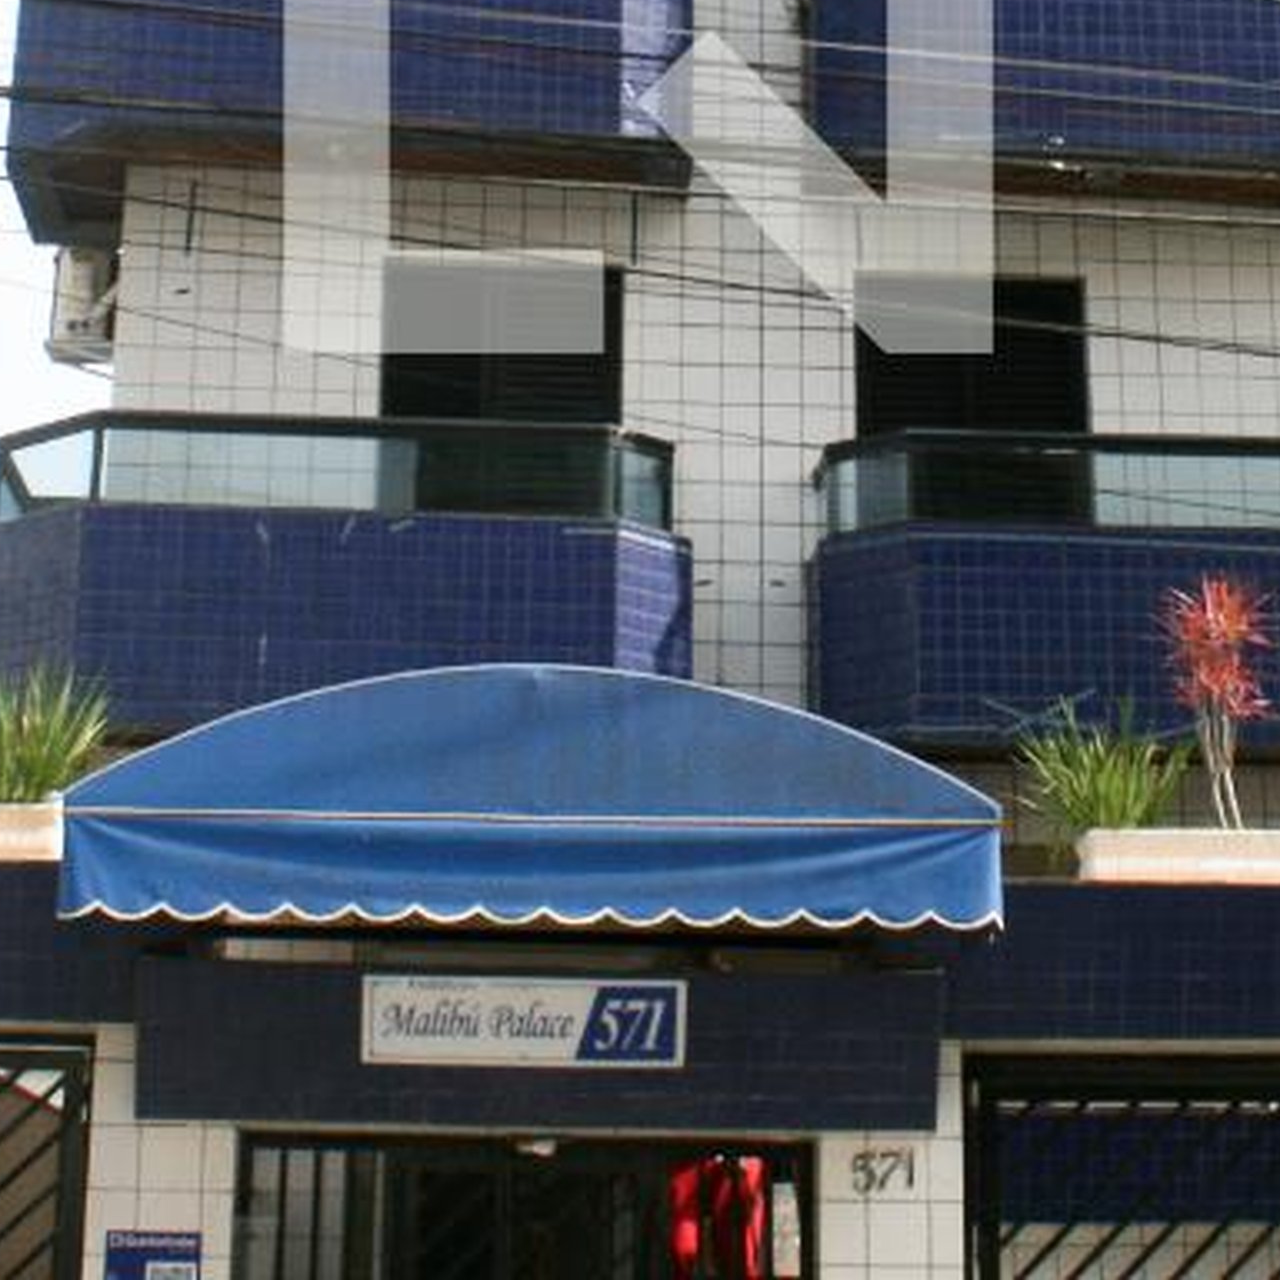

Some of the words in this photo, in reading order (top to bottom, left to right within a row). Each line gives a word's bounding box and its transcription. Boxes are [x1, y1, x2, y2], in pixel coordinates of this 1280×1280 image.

[488, 1000, 576, 1039] Palace
[593, 998, 668, 1051] 571
[851, 1147, 915, 1194] 571
